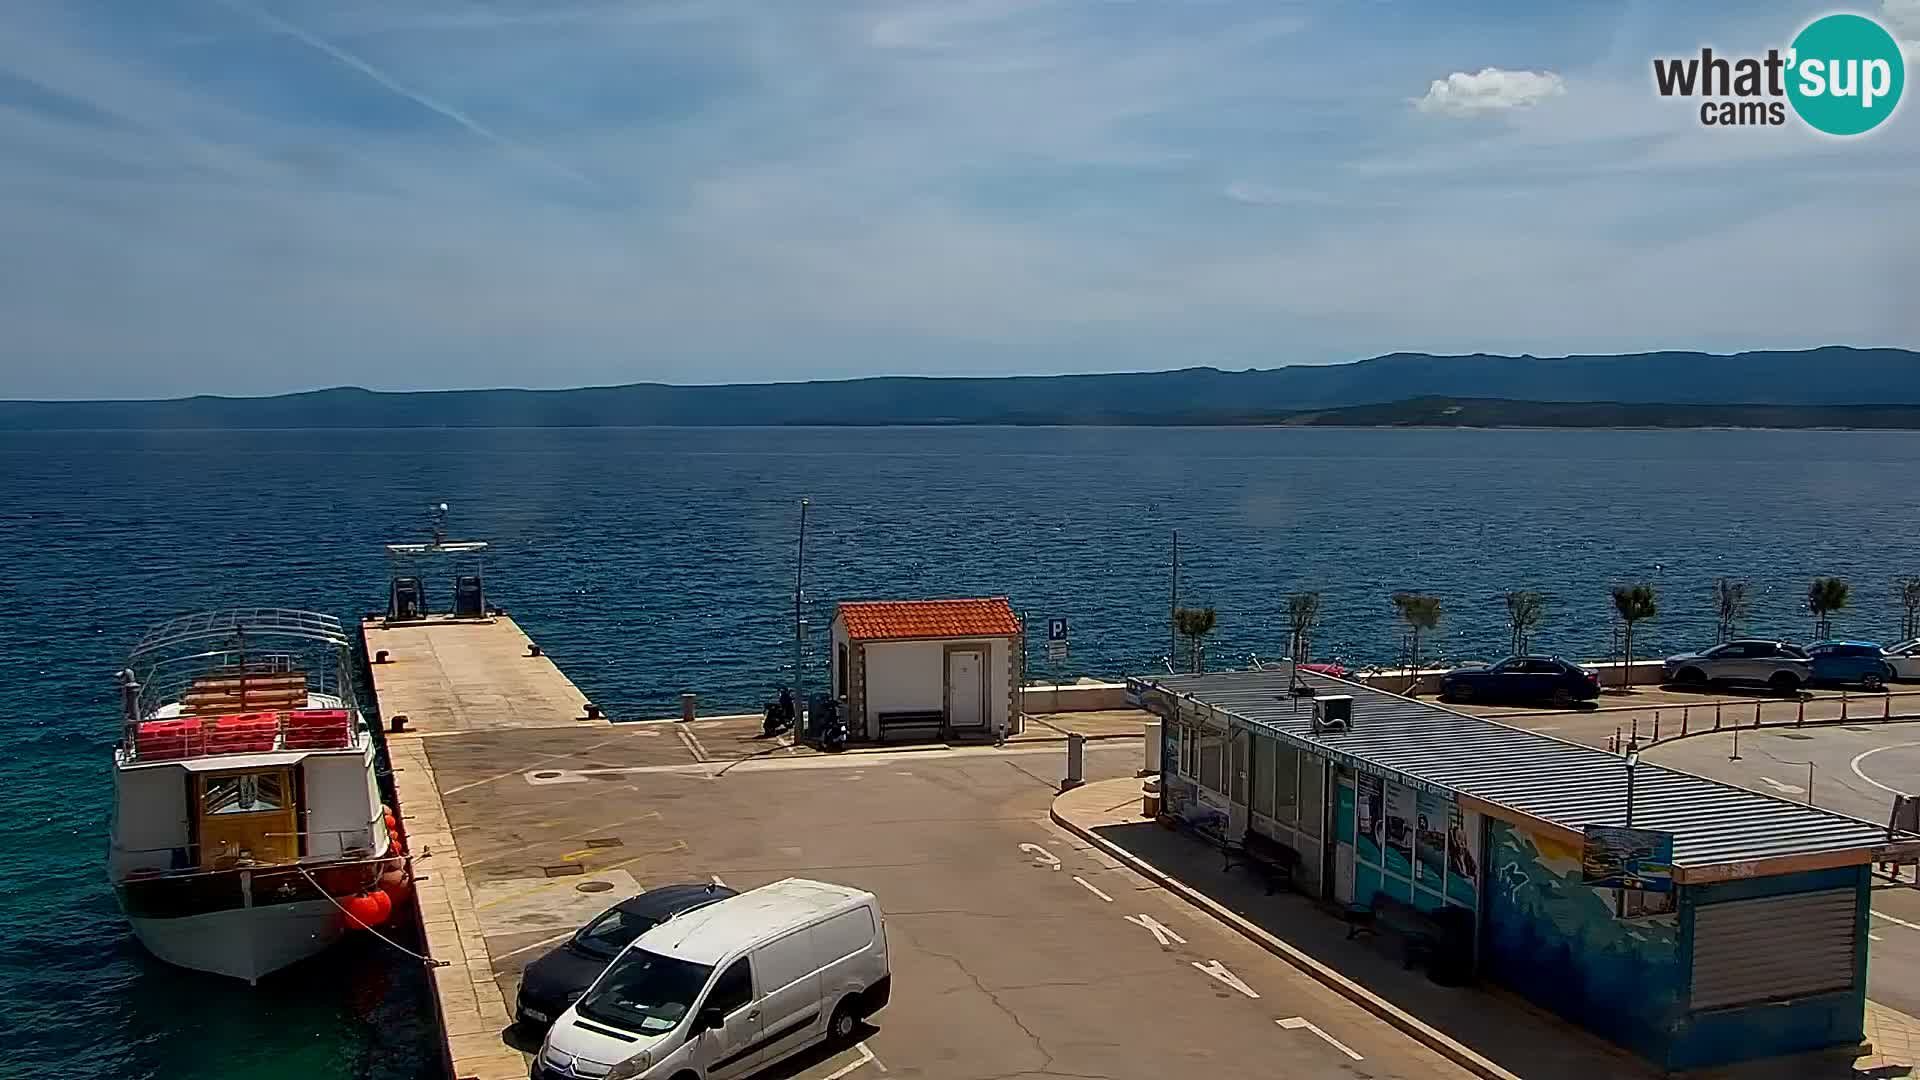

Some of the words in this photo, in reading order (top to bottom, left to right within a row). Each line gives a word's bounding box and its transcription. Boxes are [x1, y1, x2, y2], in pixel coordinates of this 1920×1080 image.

[1053, 621, 1063, 637] P
[1353, 759, 1367, 771] BUS
[1368, 763, 1399, 783] STATION
[1401, 775, 1426, 792] TICKET
